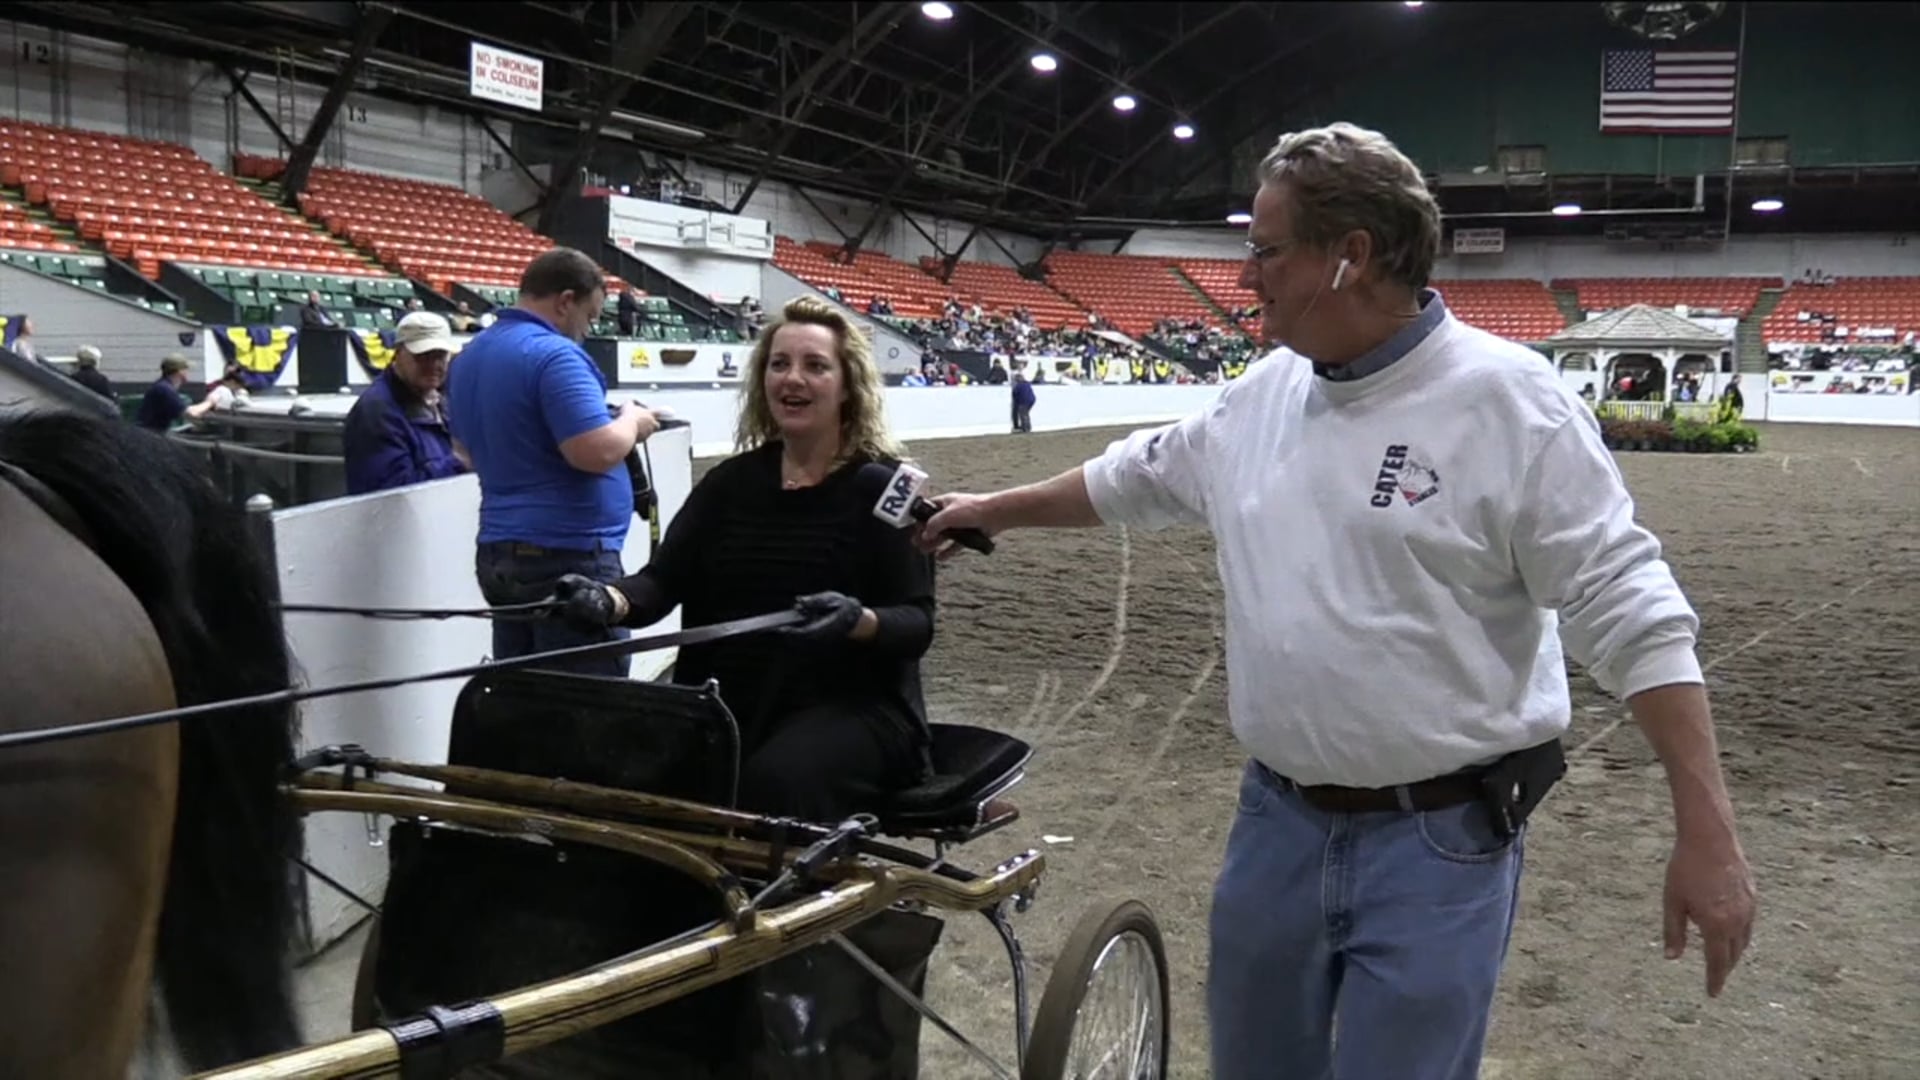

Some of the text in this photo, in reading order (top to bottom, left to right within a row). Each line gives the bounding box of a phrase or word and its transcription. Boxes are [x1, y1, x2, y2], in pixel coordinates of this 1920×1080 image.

[476, 50, 539, 77] NO SMOKING
[476, 66, 539, 91] IN COLISEUM
[1370, 444, 1408, 508] CATER
